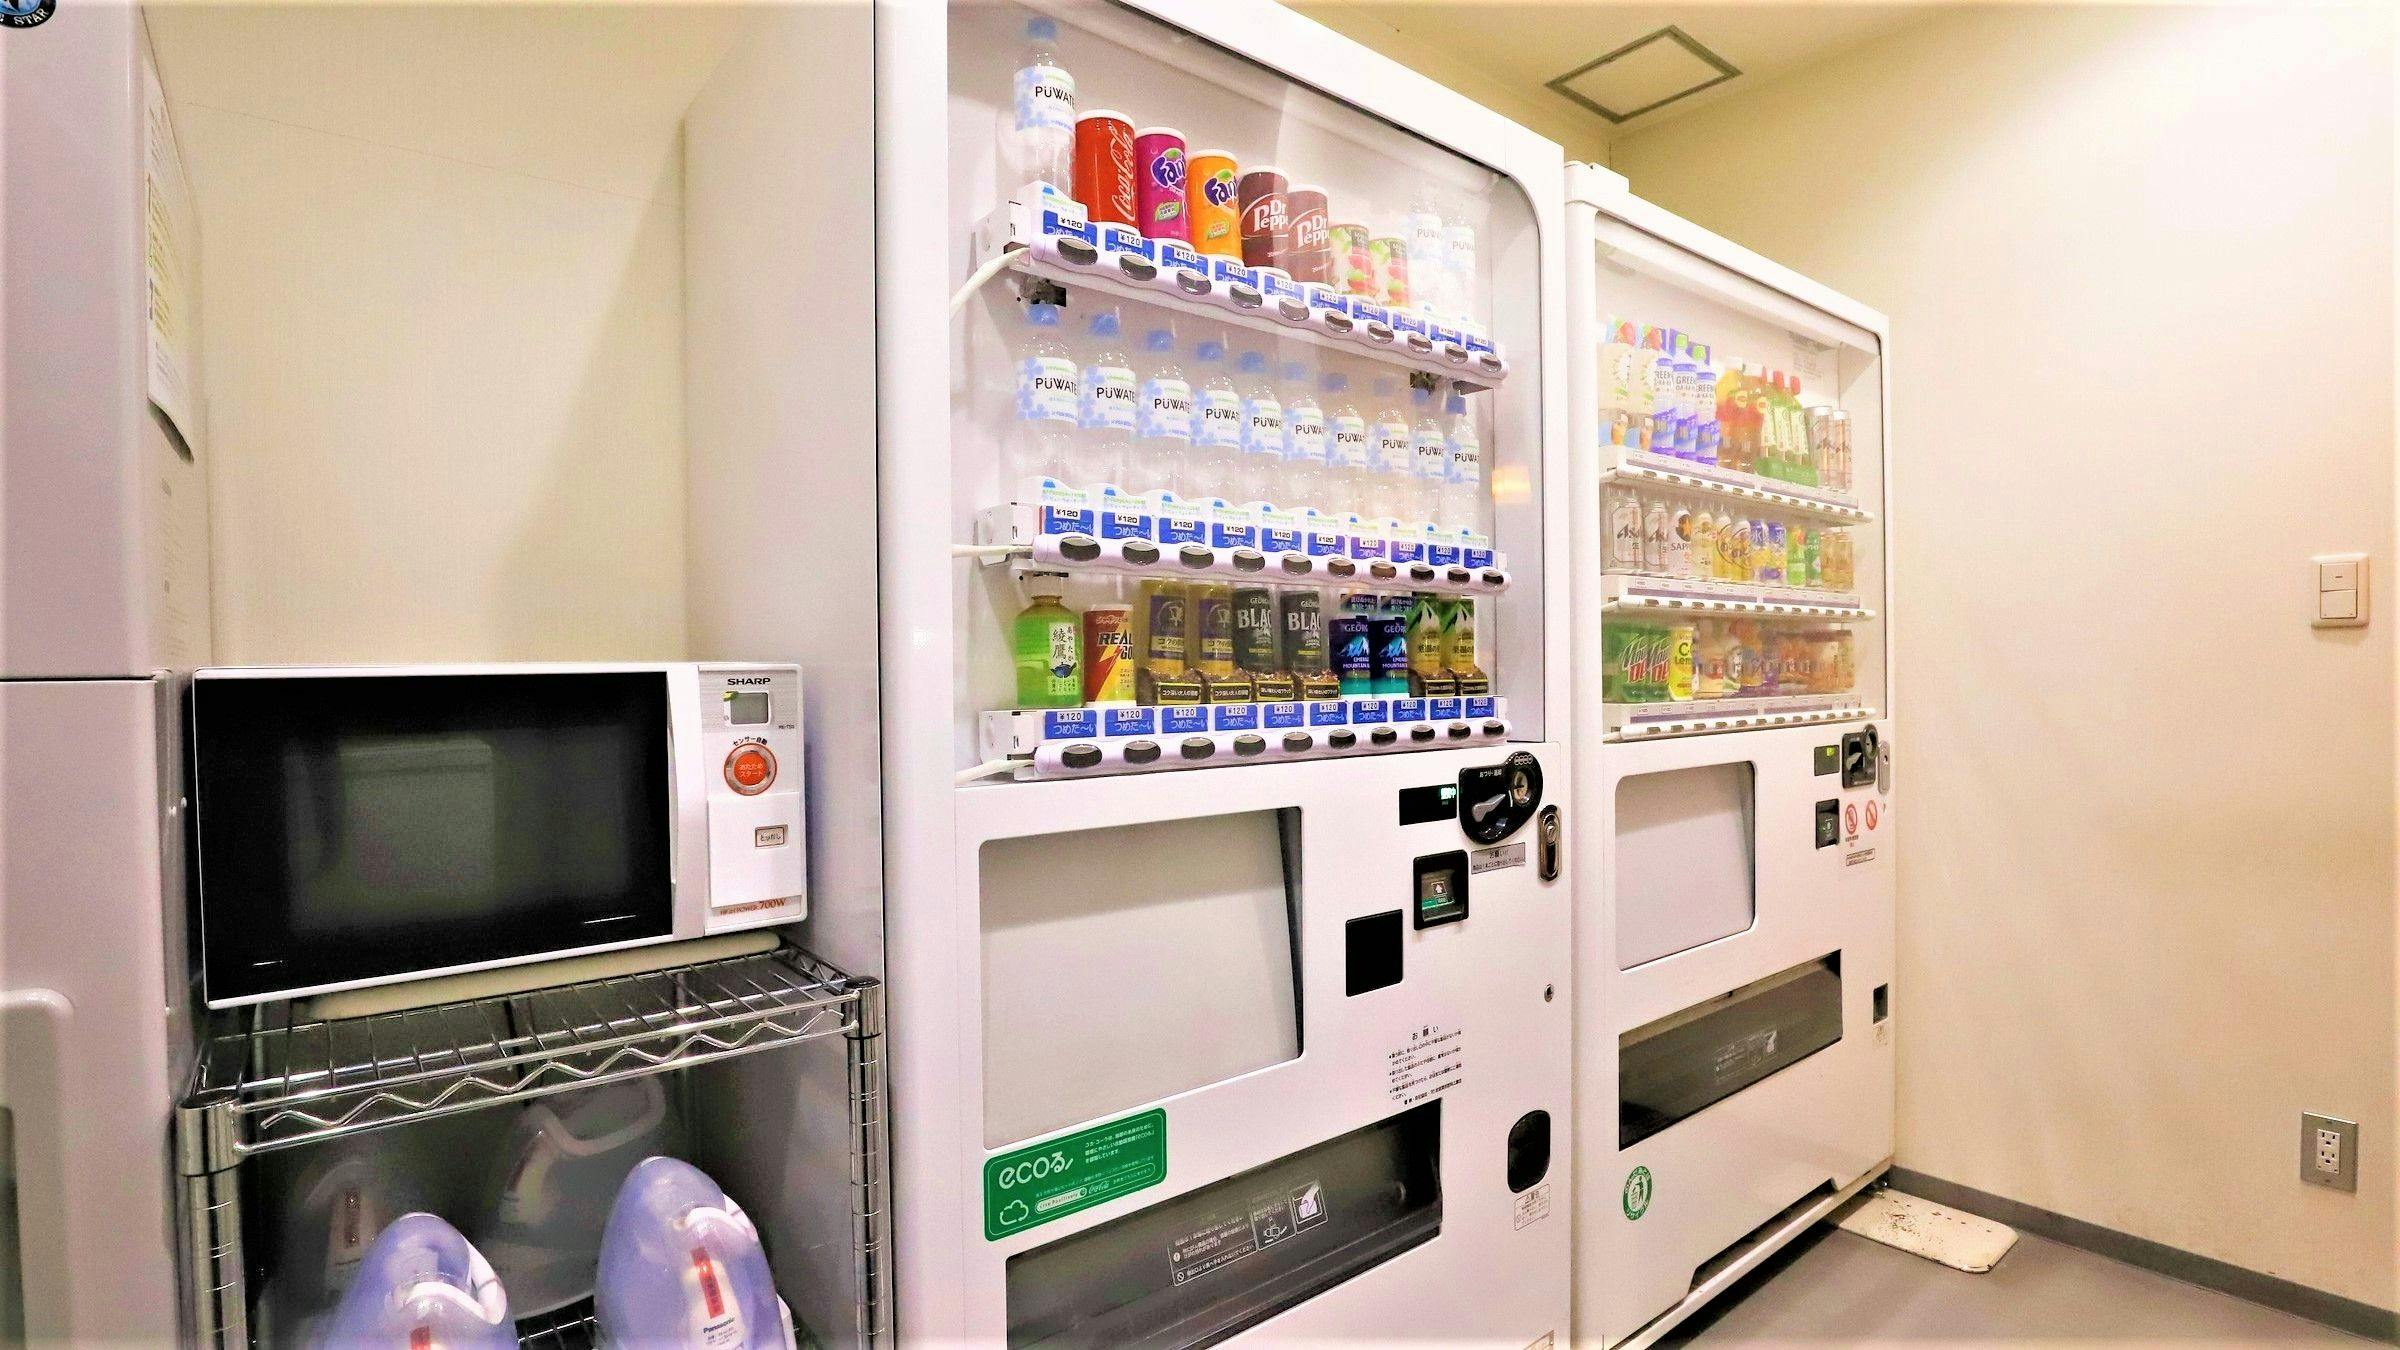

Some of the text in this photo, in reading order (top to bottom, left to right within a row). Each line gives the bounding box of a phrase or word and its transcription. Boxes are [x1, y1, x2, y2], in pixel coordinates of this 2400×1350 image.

[13, 8, 49, 25] STAR
[1269, 199, 1287, 215] Dr
[1060, 217, 1083, 229] ¥120
[1312, 215, 1328, 230] Dr
[1120, 234, 1141, 246] ¥120
[1176, 251, 1195, 261] ¥120
[1228, 266, 1246, 276] ¥120
[1056, 508, 1078, 518] ¥120
[1117, 515, 1138, 524] ¥120
[1173, 520, 1193, 529] ¥120
[1226, 525, 1244, 534] ¥120
[1274, 530, 1291, 539] ¥120
[1318, 536, 1334, 544] ¥120
[1098, 629, 1133, 647] REAL
[1120, 645, 1135, 660] GO
[727, 677, 772, 686] SHARP
[1276, 704, 1293, 713] ¥120
[1321, 703, 1337, 712] ¥120
[1362, 702, 1378, 710] ¥120
[1402, 700, 1417, 709] ¥120
[1119, 710, 1140, 719] ¥120
[1175, 708, 1194, 717] ¥120
[1227, 706, 1246, 716] ¥120
[1059, 712, 1081, 721] ¥120
[759, 897, 787, 909] 700W
[703, 1316, 735, 1333] Panasonic
